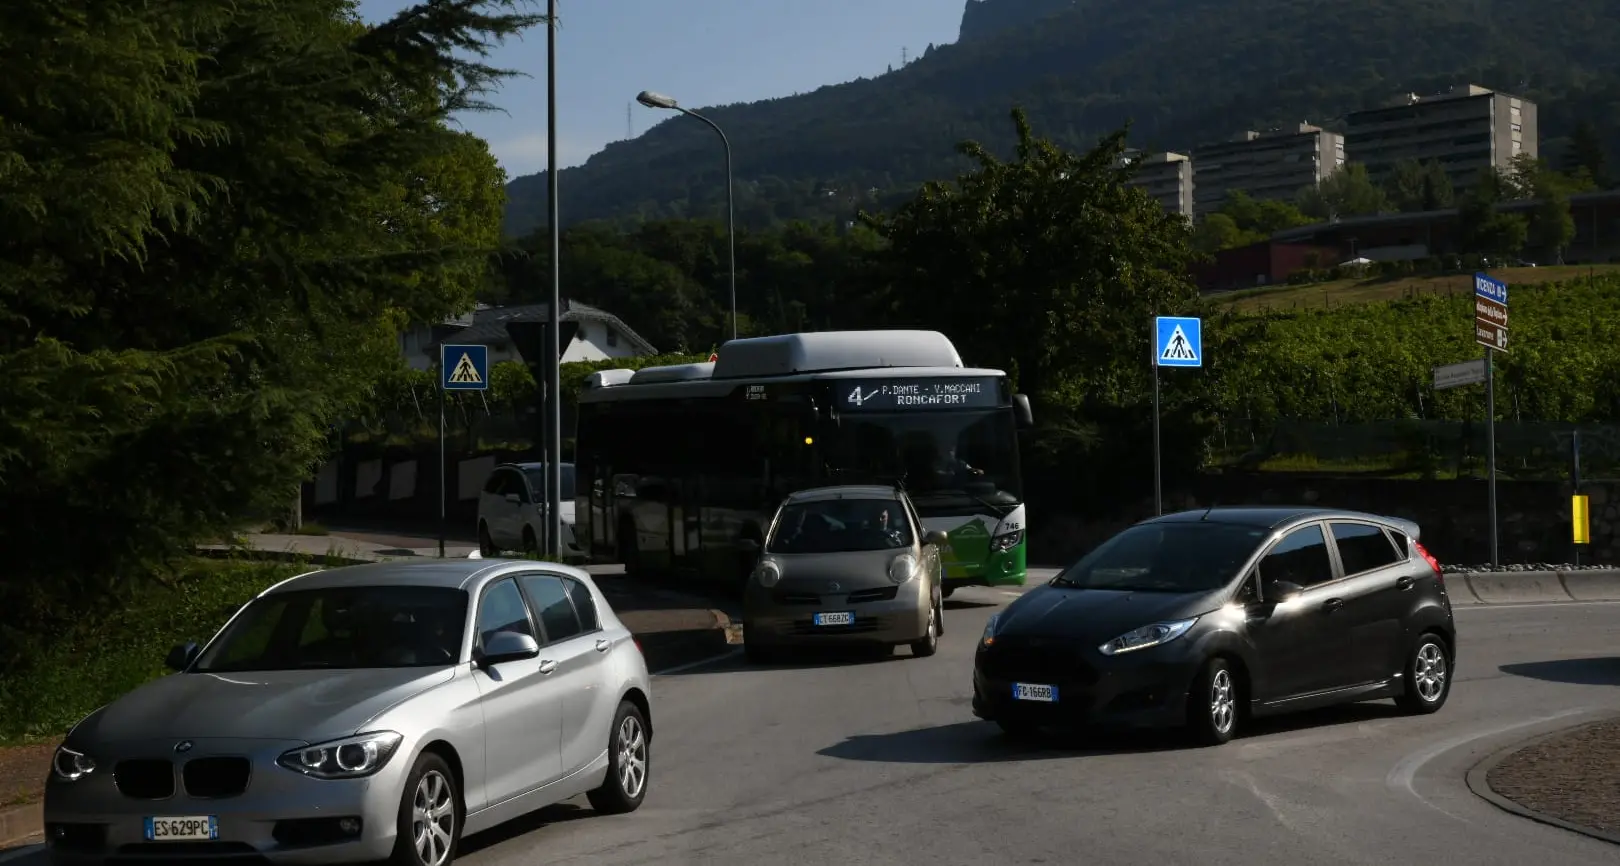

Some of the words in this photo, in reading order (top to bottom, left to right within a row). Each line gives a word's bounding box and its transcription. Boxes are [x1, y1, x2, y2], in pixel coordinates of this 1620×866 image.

[1476, 276, 1496, 296] VICENZA
[882, 385, 919, 395] P.DANTE
[934, 383, 981, 394] V.MACCANI
[897, 394, 967, 405] RONCAFORT
[1005, 522, 1020, 531] 746
